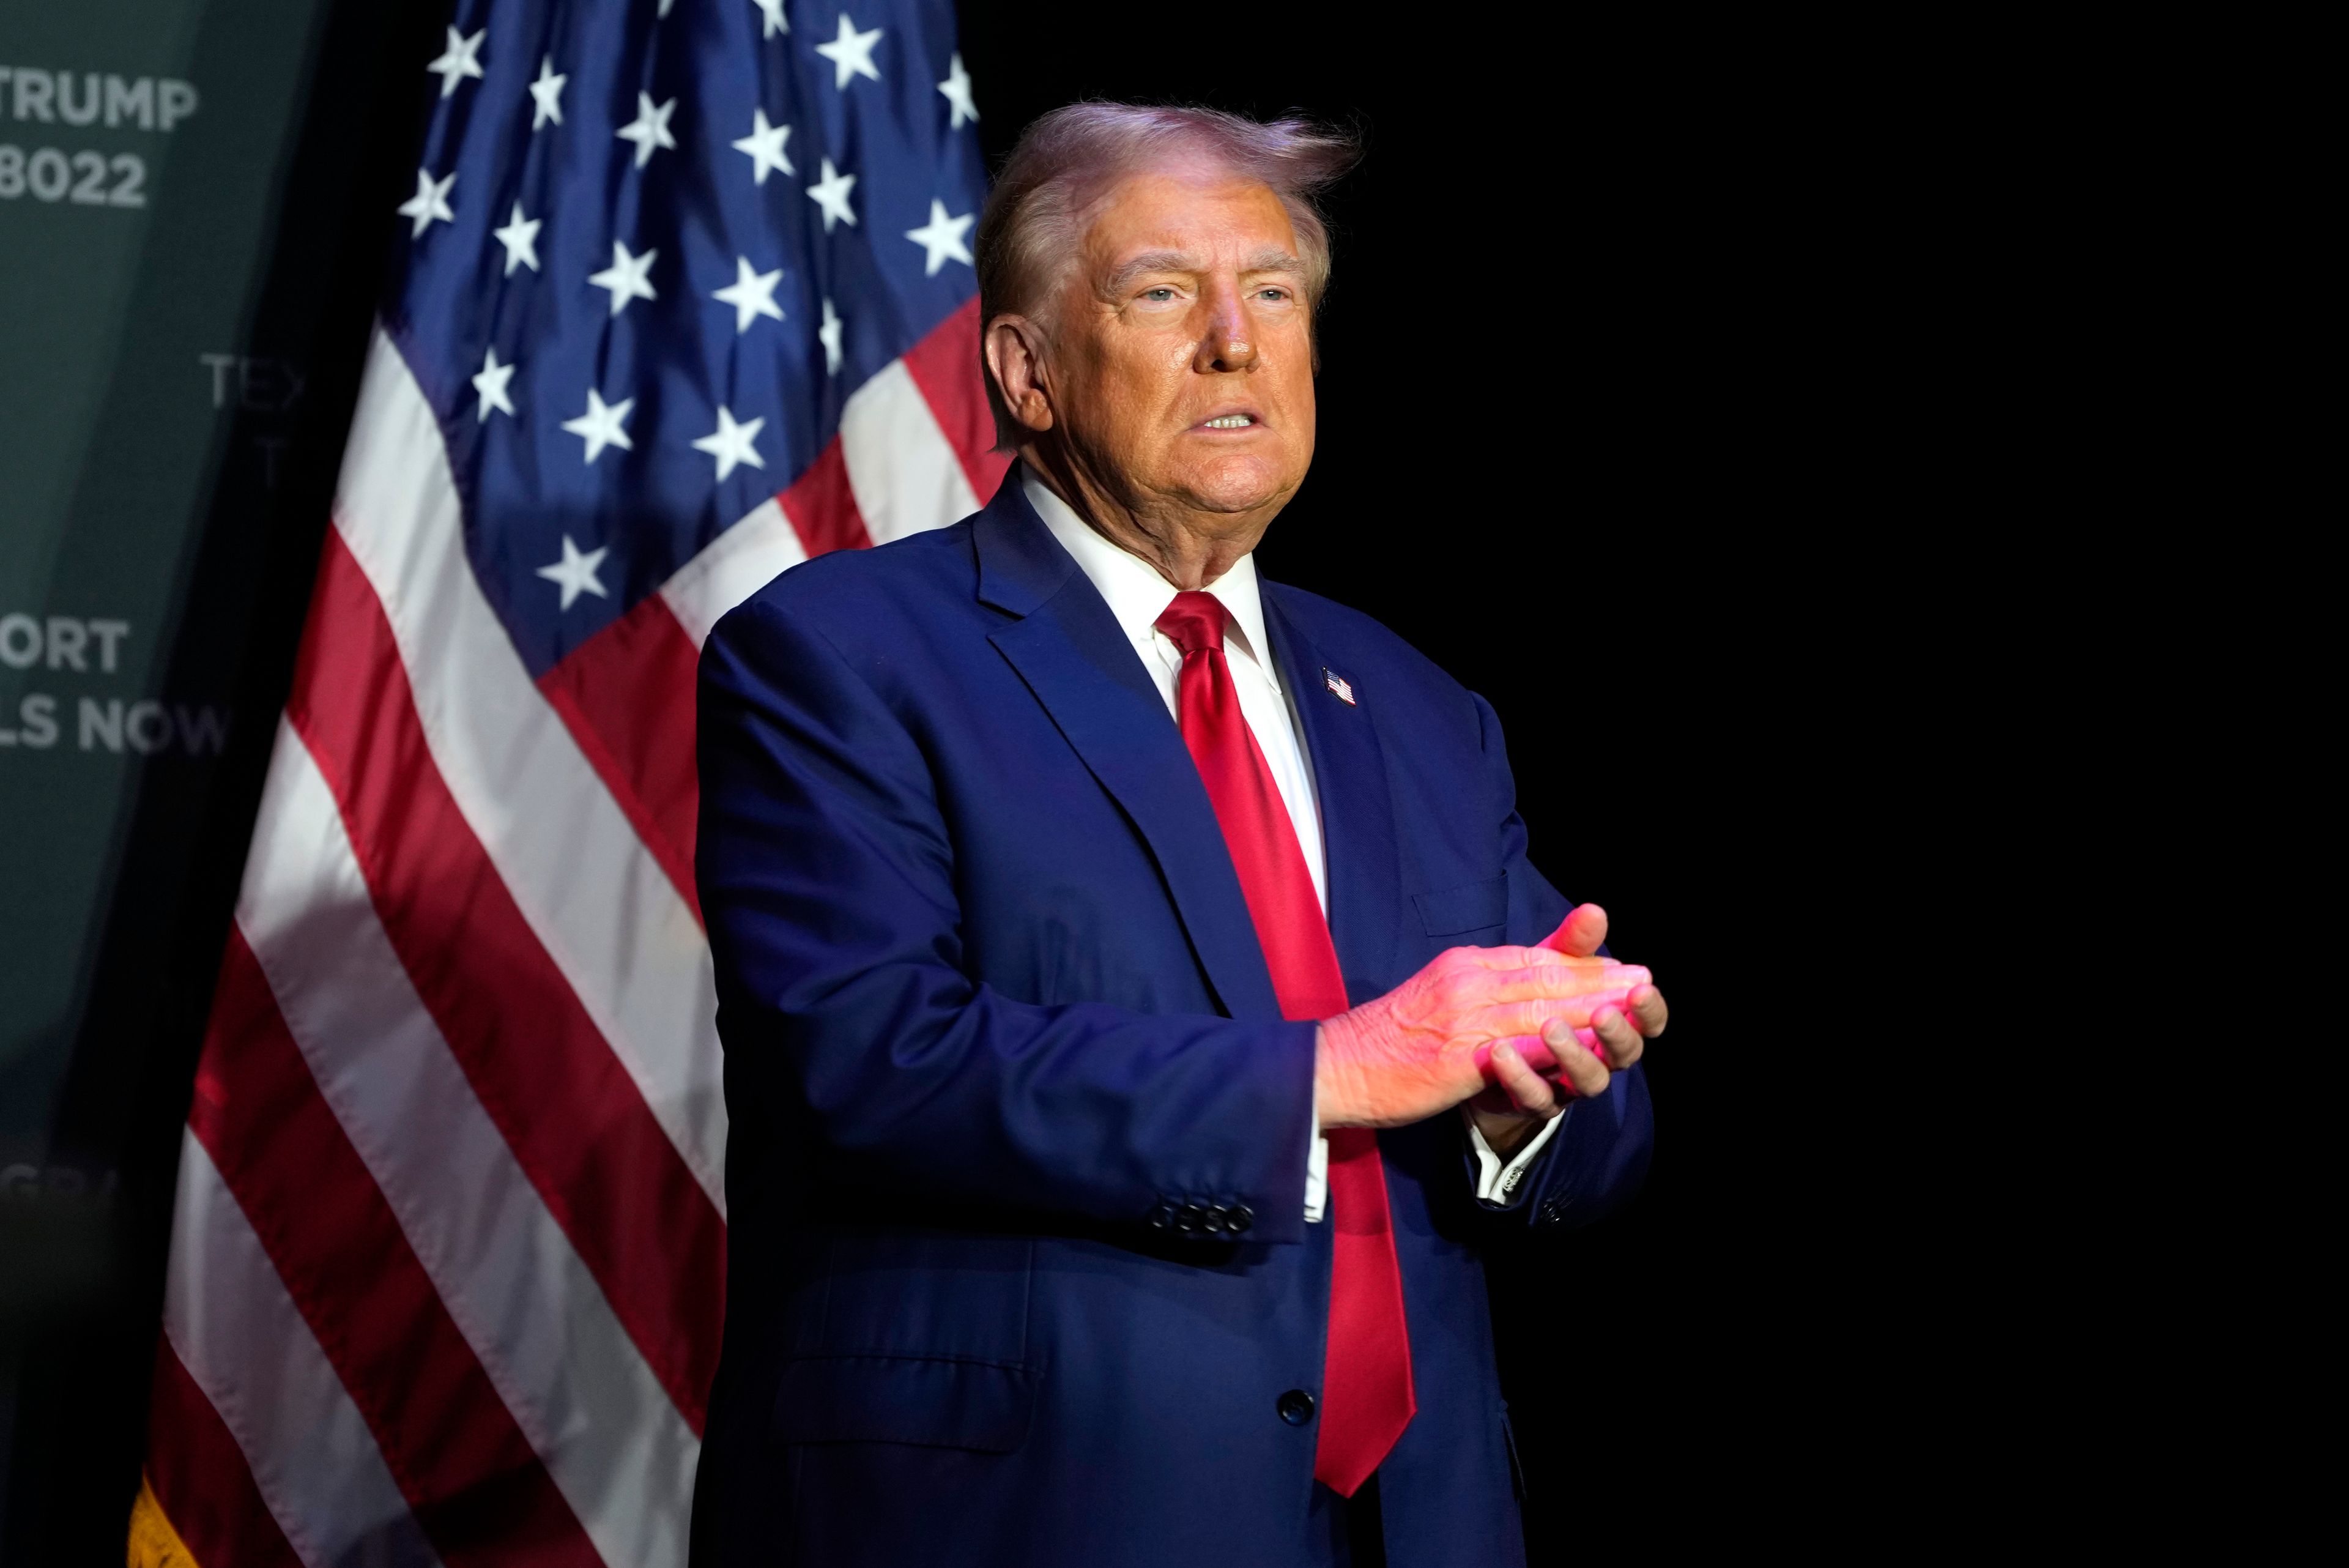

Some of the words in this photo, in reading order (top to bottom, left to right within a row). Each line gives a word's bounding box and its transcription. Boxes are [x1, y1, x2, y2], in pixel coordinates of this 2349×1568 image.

[0, 65, 199, 132] RUMP
[0, 613, 130, 672] ORT
[77, 696, 236, 757] NOW
